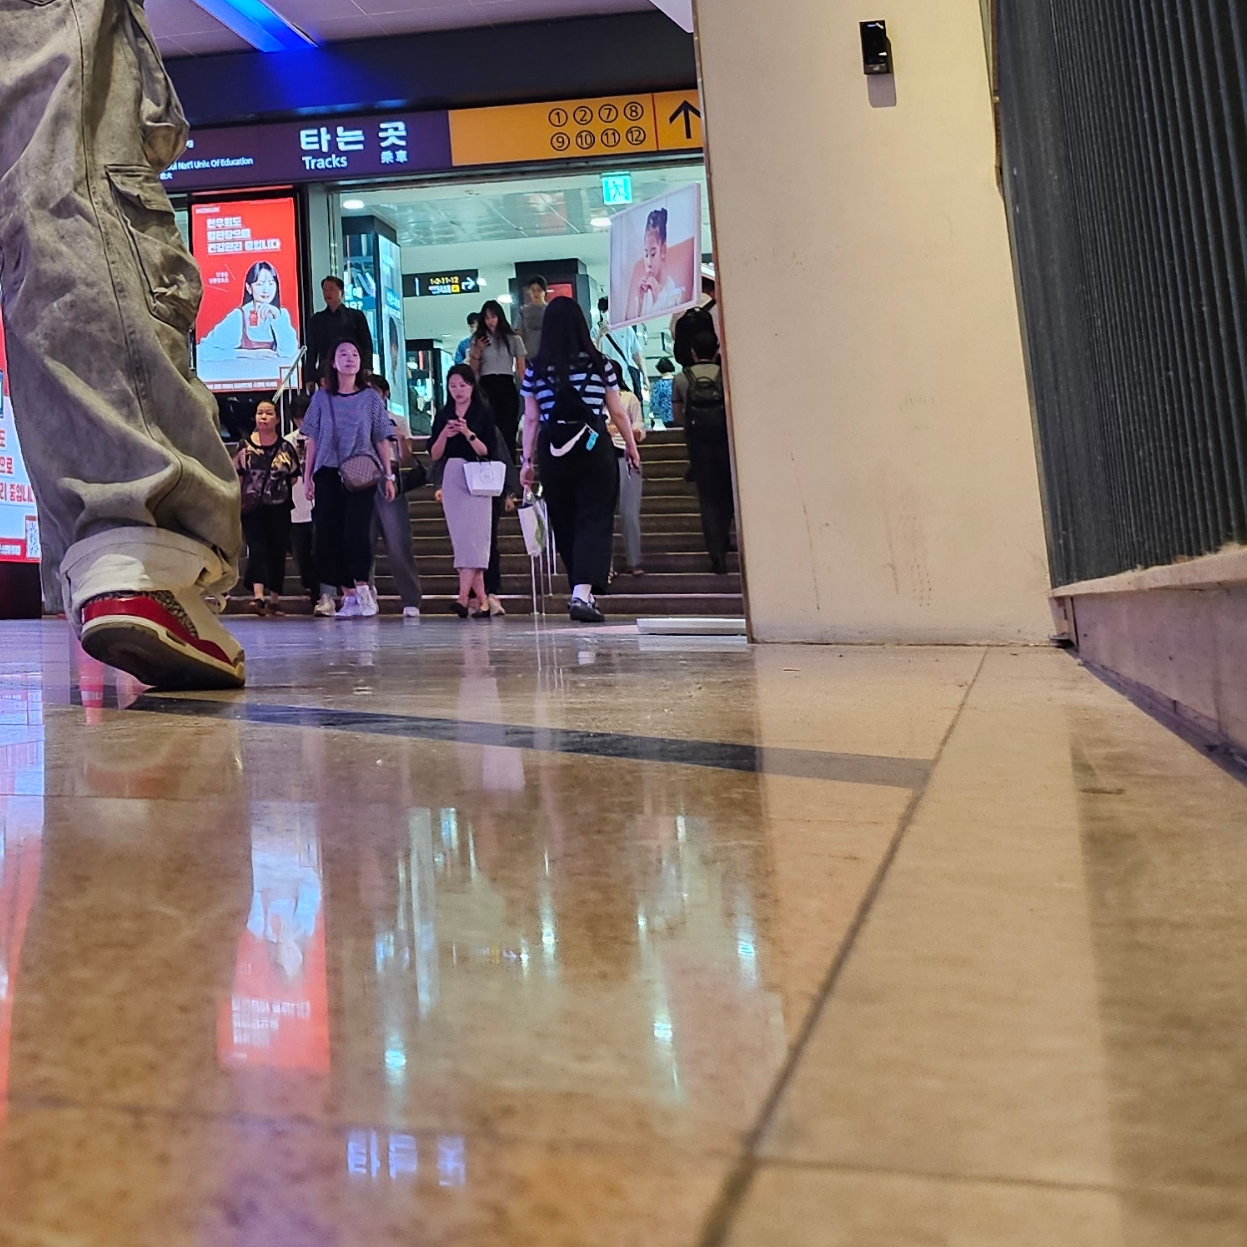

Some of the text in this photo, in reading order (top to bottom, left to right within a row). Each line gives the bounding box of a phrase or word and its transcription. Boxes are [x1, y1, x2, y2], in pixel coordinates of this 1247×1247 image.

[300, 120, 408, 152] 타는 곳
[220, 156, 254, 167] Education
[302, 154, 348, 171] Tracks
